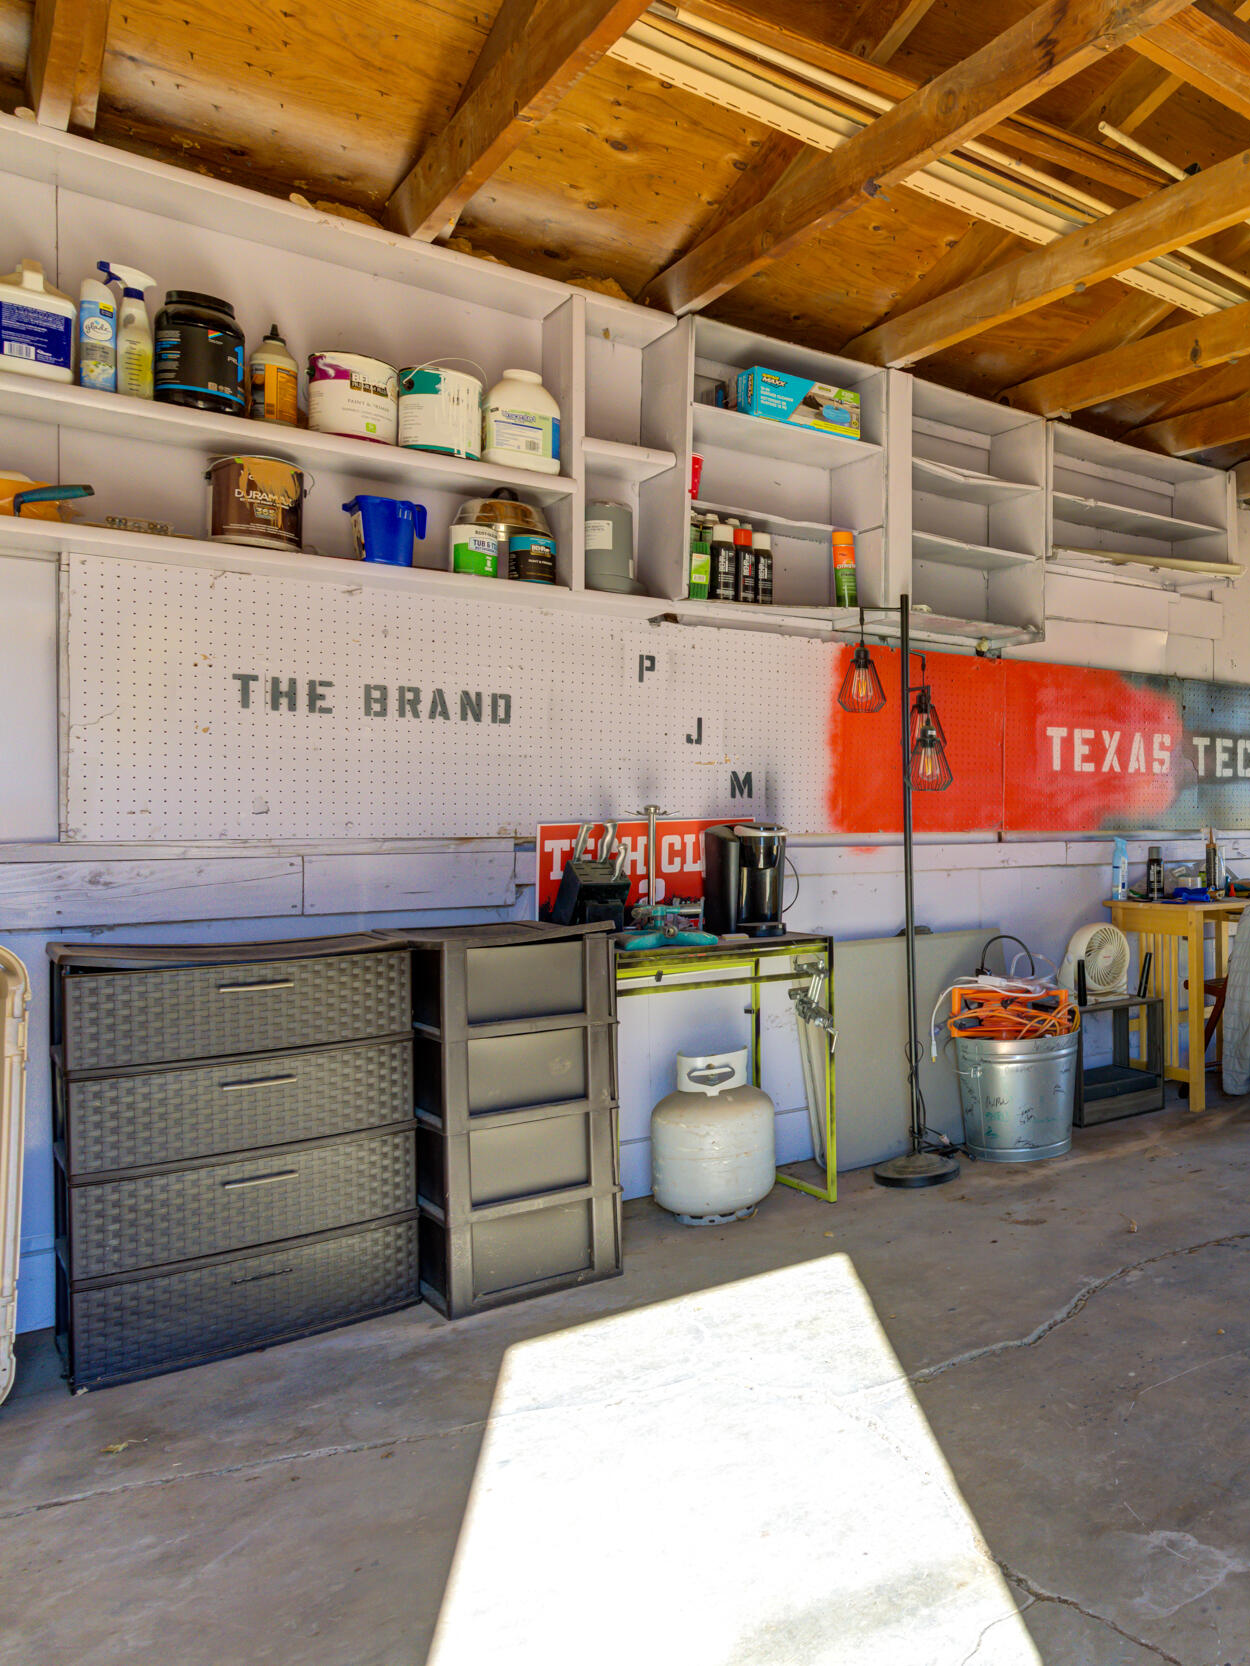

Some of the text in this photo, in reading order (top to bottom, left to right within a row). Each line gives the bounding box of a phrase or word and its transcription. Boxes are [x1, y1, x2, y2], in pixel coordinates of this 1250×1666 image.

[232, 673, 512, 725] THE BRAND
[1046, 727, 1171, 774] TEXAS
[730, 771, 753, 799] M
